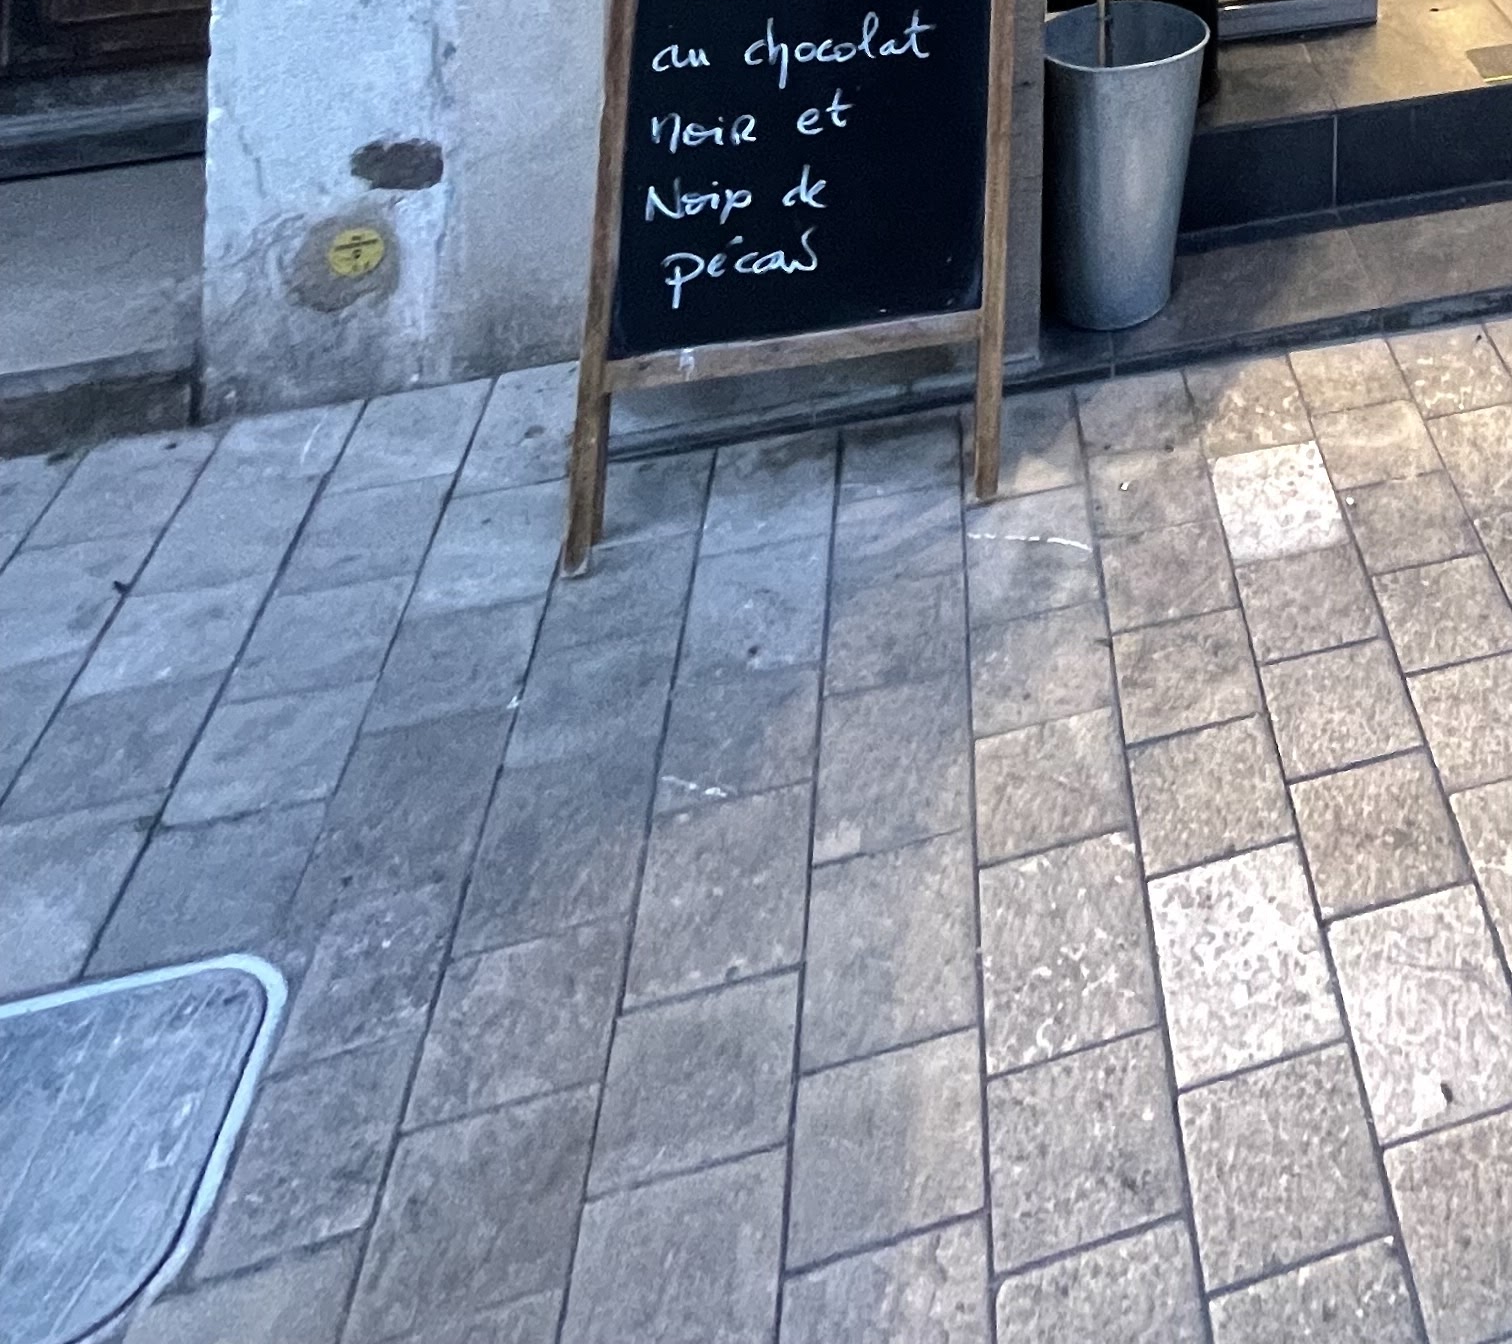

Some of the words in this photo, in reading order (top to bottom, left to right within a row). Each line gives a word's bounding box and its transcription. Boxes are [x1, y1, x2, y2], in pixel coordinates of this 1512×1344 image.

[651, 43, 711, 73] au
[743, 8, 938, 91] chocolat
[796, 88, 856, 136] et
